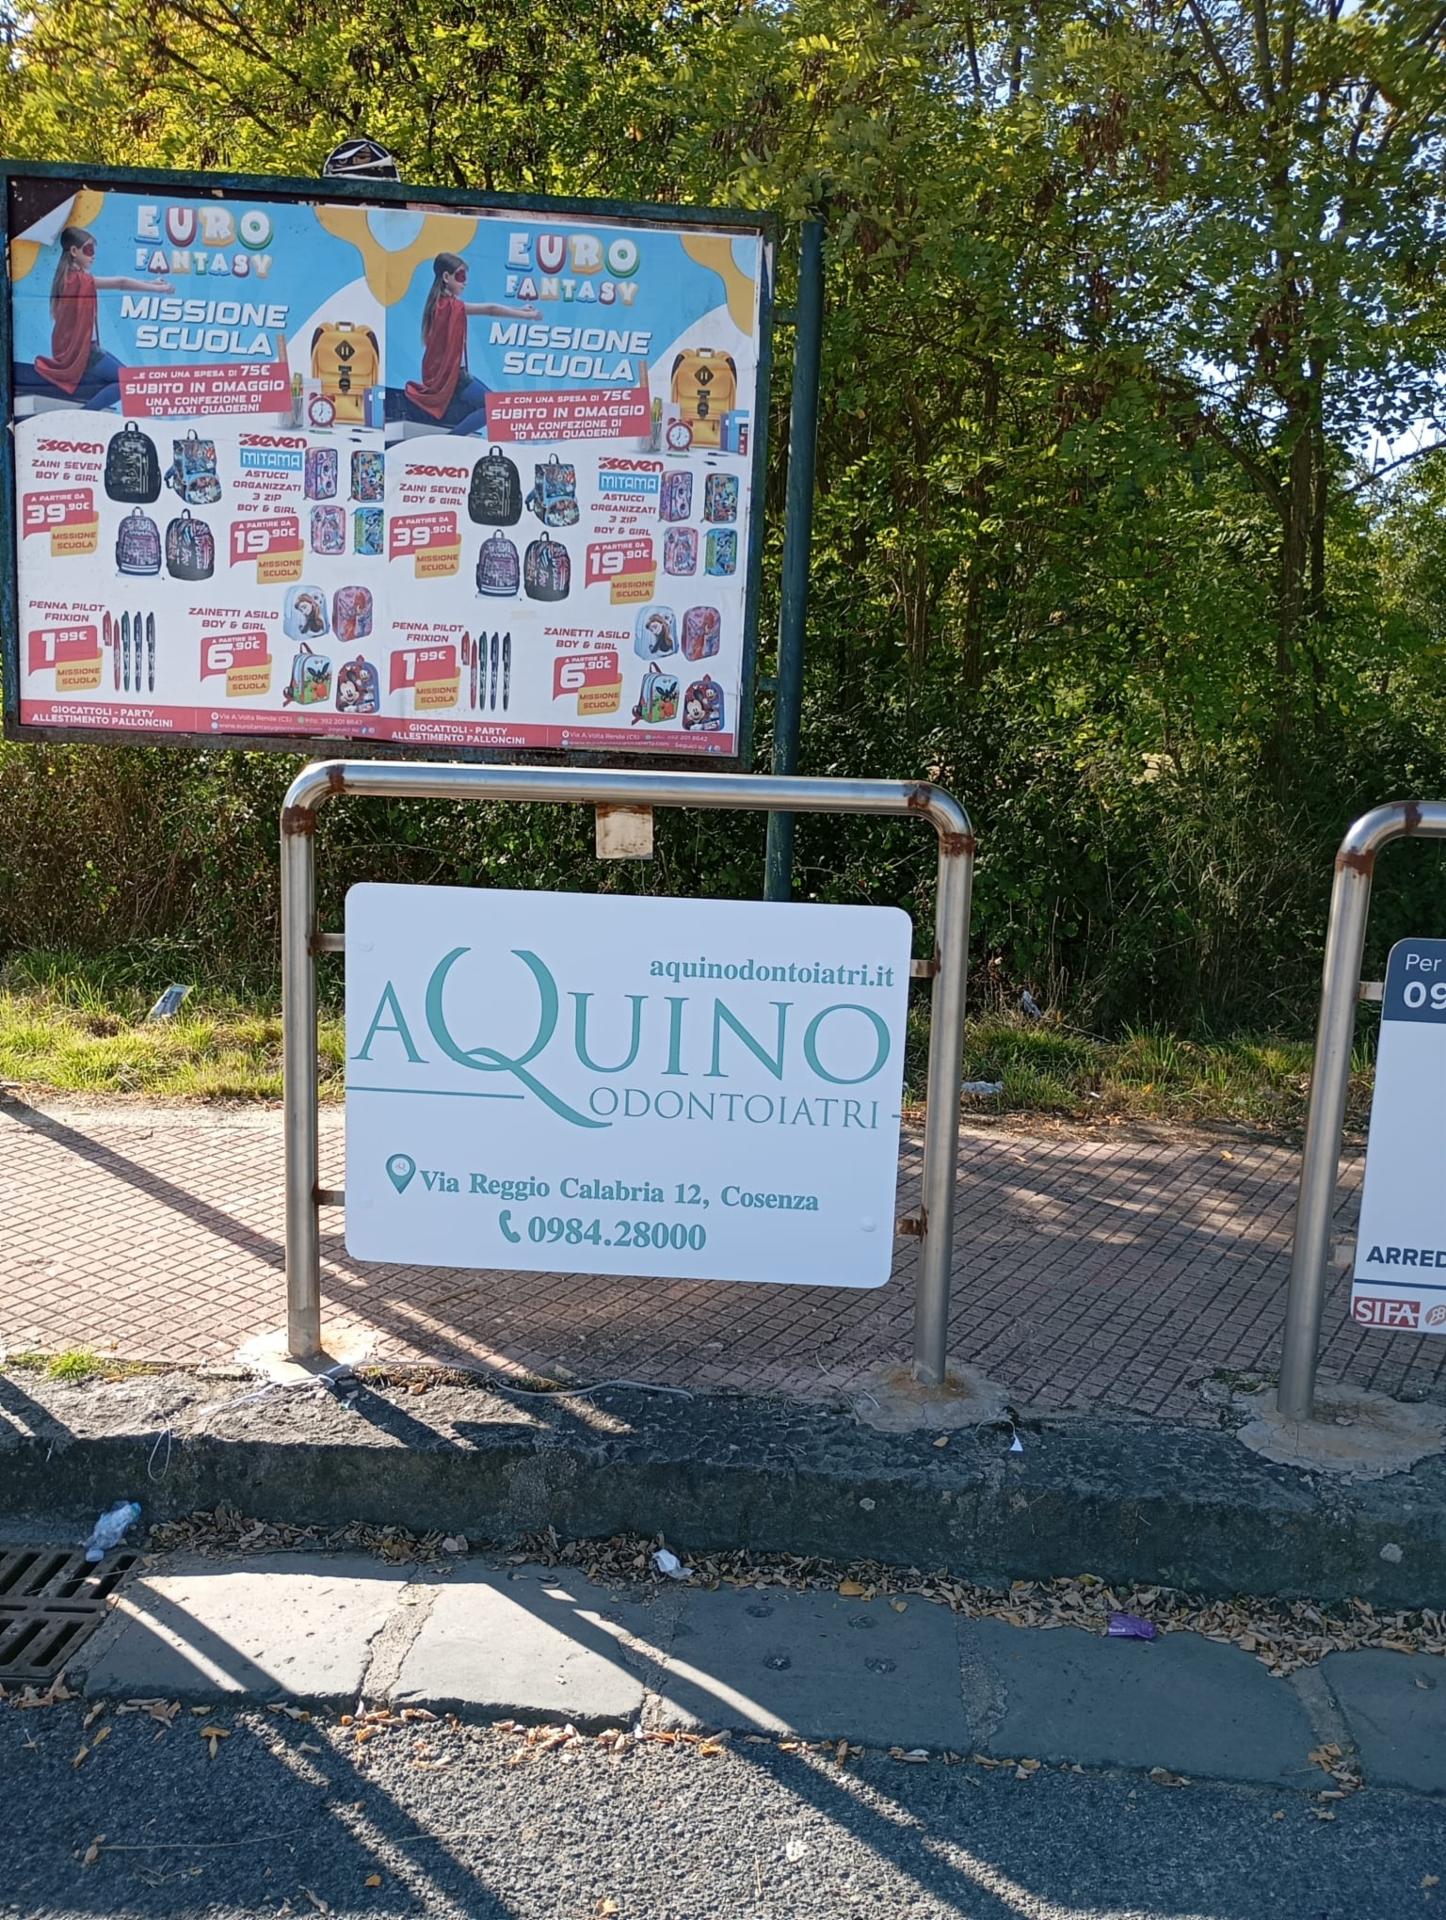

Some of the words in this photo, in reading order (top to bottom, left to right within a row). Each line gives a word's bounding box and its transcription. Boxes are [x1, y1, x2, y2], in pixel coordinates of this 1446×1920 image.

[135, 205, 274, 250] EURO
[505, 232, 640, 278] EURO
[135, 248, 273, 279] FANTASY
[504, 274, 640, 306] FANTASY
[120, 296, 290, 328] MISSIONE
[135, 325, 273, 356] SCUOLA
[489, 322, 652, 354] MISSIONE
[149, 371, 168, 379] CON
[171, 370, 191, 379] UNA
[194, 369, 225, 378] SPESA
[228, 369, 238, 377] DI
[240, 364, 271, 377] 75€
[502, 351, 634, 381] SCUOLA
[125, 382, 184, 395] SUBITO
[190, 382, 206, 392] IN
[212, 380, 285, 393] OMAGGIO
[146, 397, 170, 406] UNA
[175, 395, 246, 405] CONFEZIONE
[251, 395, 262, 403] DI
[514, 397, 532, 405] CON
[536, 396, 554, 404] UNA
[558, 395, 588, 403] SPESA
[602, 390, 632, 402] 75€
[151, 406, 163, 415] 10
[168, 405, 197, 415] MAXI
[201, 404, 260, 414] QUADERNI
[491, 408, 547, 420] SUBITO
[553, 408, 568, 418] IN
[575, 405, 645, 418] OMAGGIO
[510, 421, 534, 431] UNA
[538, 420, 607, 430] CONFEZIONE
[611, 419, 622, 427] DI
[515, 431, 527, 440] 10
[531, 430, 559, 440] MAXI
[563, 429, 619, 438] QUADERNI
[32, 459, 61, 469] ZAINI
[64, 461, 102, 471] SEVEN
[242, 452, 300, 468] MITAMA
[35, 471, 59, 480] BOY
[63, 472, 70, 480] &
[75, 472, 99, 482] GIRL
[245, 470, 289, 479] ASTUCCI
[233, 480, 301, 492] ORGANIZZATI
[601, 474, 657, 490] MITAMA
[399, 483, 427, 493] ZAINI
[430, 485, 467, 495] SEVEN
[252, 493, 261, 501] 3
[265, 493, 282, 502] ZIP
[402, 495, 425, 504] BOY
[428, 497, 436, 505] &
[440, 497, 463, 506] GIRL
[603, 492, 645, 501] ASTUCCI
[237, 503, 259, 512] BOY
[262, 505, 270, 513] &
[274, 505, 297, 514] GIRL
[590, 503, 656, 514] ORGANIZZATI
[608, 515, 616, 523] 3
[620, 515, 637, 523] ZIP
[52, 531, 96, 540] MISSIONE
[594, 525, 615, 534] BOY
[618, 527, 626, 535] &
[629, 527, 651, 536] GIRL
[57, 541, 93, 549] SCUOLA
[416, 553, 459, 562] MISSIONE
[258, 560, 301, 568] MISSIONE
[421, 563, 456, 571] SCUOLA
[263, 569, 299, 577] SCUOLA
[612, 580, 654, 589] MISSIONE
[616, 589, 650, 598] SCUOLA
[29, 600, 68, 610] PENNA
[72, 603, 105, 612] PILOT
[44, 612, 89, 622] FRIXION
[188, 607, 241, 617] ZAINETTI
[244, 610, 279, 620] ASILO
[202, 620, 226, 629] BOY
[230, 621, 237, 629] &
[242, 623, 266, 631] GIRL
[392, 621, 429, 631] PENNA
[433, 623, 464, 632] PILOT
[407, 633, 449, 643] FRIXION
[544, 627, 594, 637] ZAINETTI
[597, 630, 630, 639] ASILO
[556, 640, 579, 648] BOY
[594, 642, 617, 650] GIRL
[57, 668, 100, 676] MISSIONE
[228, 673, 270, 682] MISSIONE
[61, 676, 97, 685] SCUOLA
[232, 682, 267, 690] SCUOLA
[416, 686, 458, 695] MISSIONE
[421, 695, 455, 704] SCUOLA
[580, 693, 619, 701] MISSIONE
[583, 701, 616, 709] SCUOLA
[51, 705, 112, 716] GIOCATTOLI
[121, 708, 154, 717] PARTY
[32, 714, 109, 725] ALLESTIMENTO
[112, 717, 173, 728] PALLONCINI
[409, 723, 468, 734] GIOCATTOLI
[475, 726, 508, 736] PARTY
[391, 731, 464, 742] ALLESTIMENTO
[466, 735, 526, 745] PALLONCINI
[1405, 953, 1442, 972] Per
[650, 956, 895, 987] aquinodontoiatri.it
[350, 947, 891, 1128] AQUINO
[589, 1086, 879, 1129] ODONTOIATRI
[420, 1170, 460, 1193] Via
[468, 1173, 550, 1201] Reggio
[560, 1177, 665, 1203] Calabria
[674, 1183, 710, 1210] 12,
[720, 1185, 819, 1211] Cosenza
[528, 1216, 707, 1251] 0984.28000
[1355, 1300, 1418, 1326] SIFA
